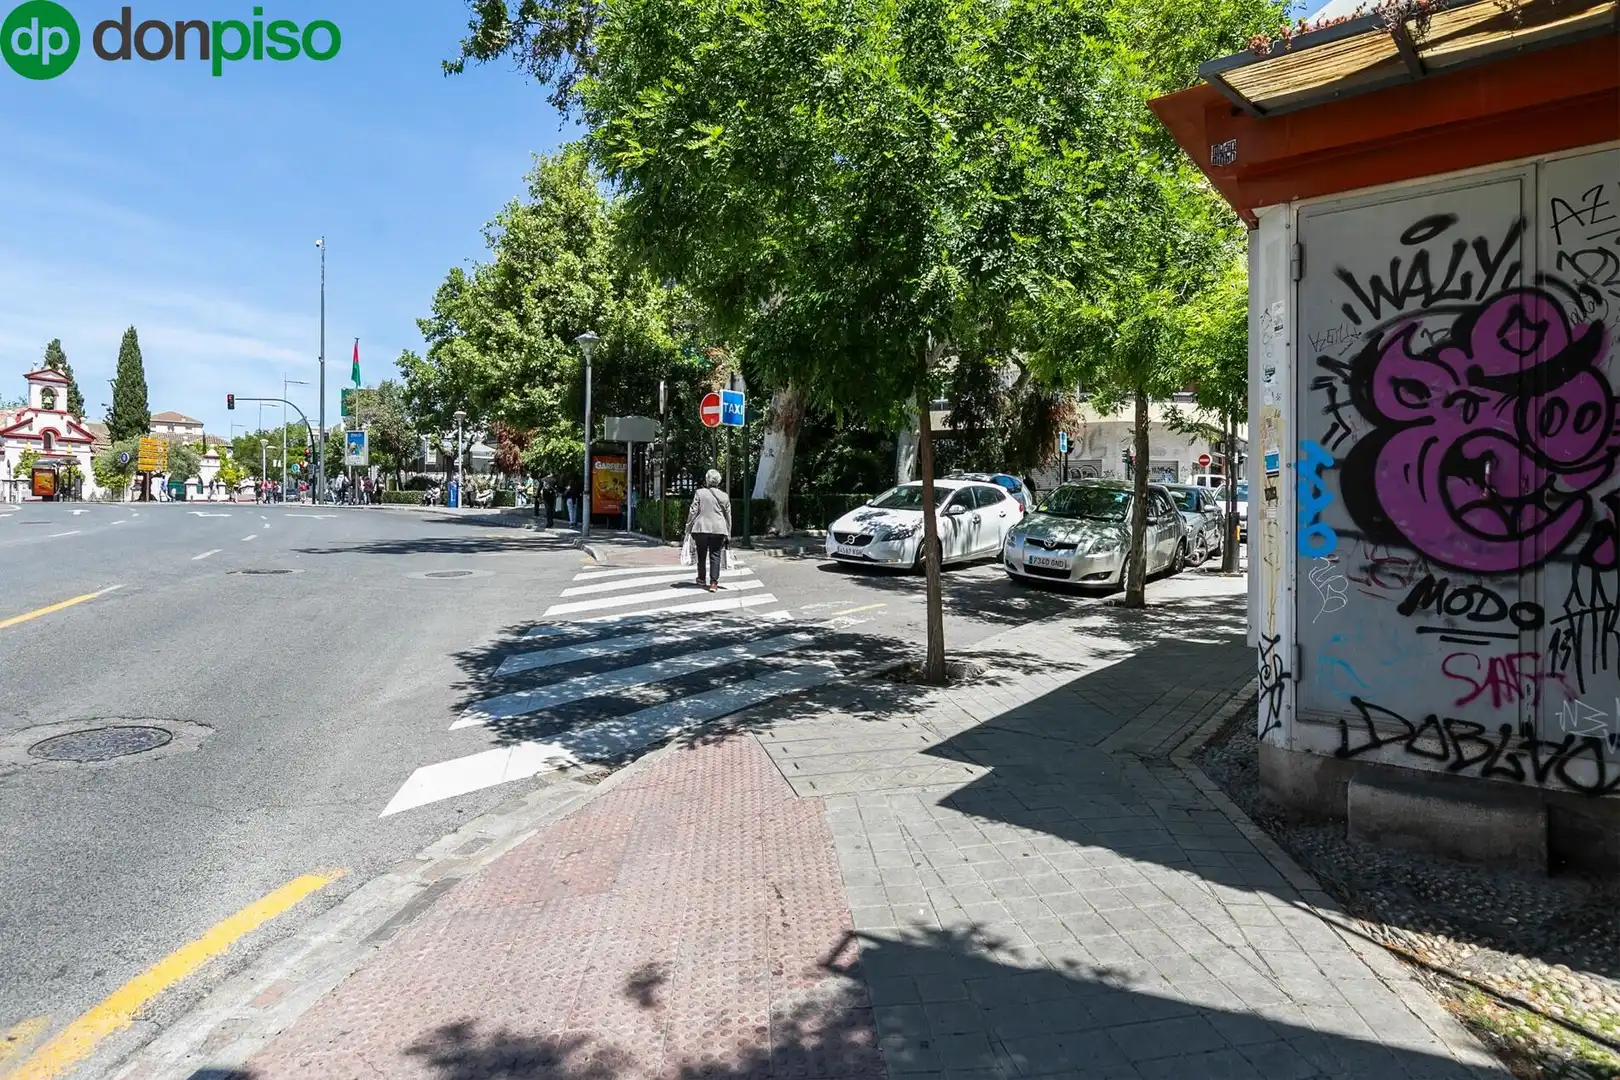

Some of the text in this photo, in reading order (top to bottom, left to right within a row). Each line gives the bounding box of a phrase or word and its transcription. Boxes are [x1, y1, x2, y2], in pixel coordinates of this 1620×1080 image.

[723, 402, 744, 415] TAXI
[594, 460, 628, 470] GARFIELD
[1397, 574, 1545, 631] MODO
